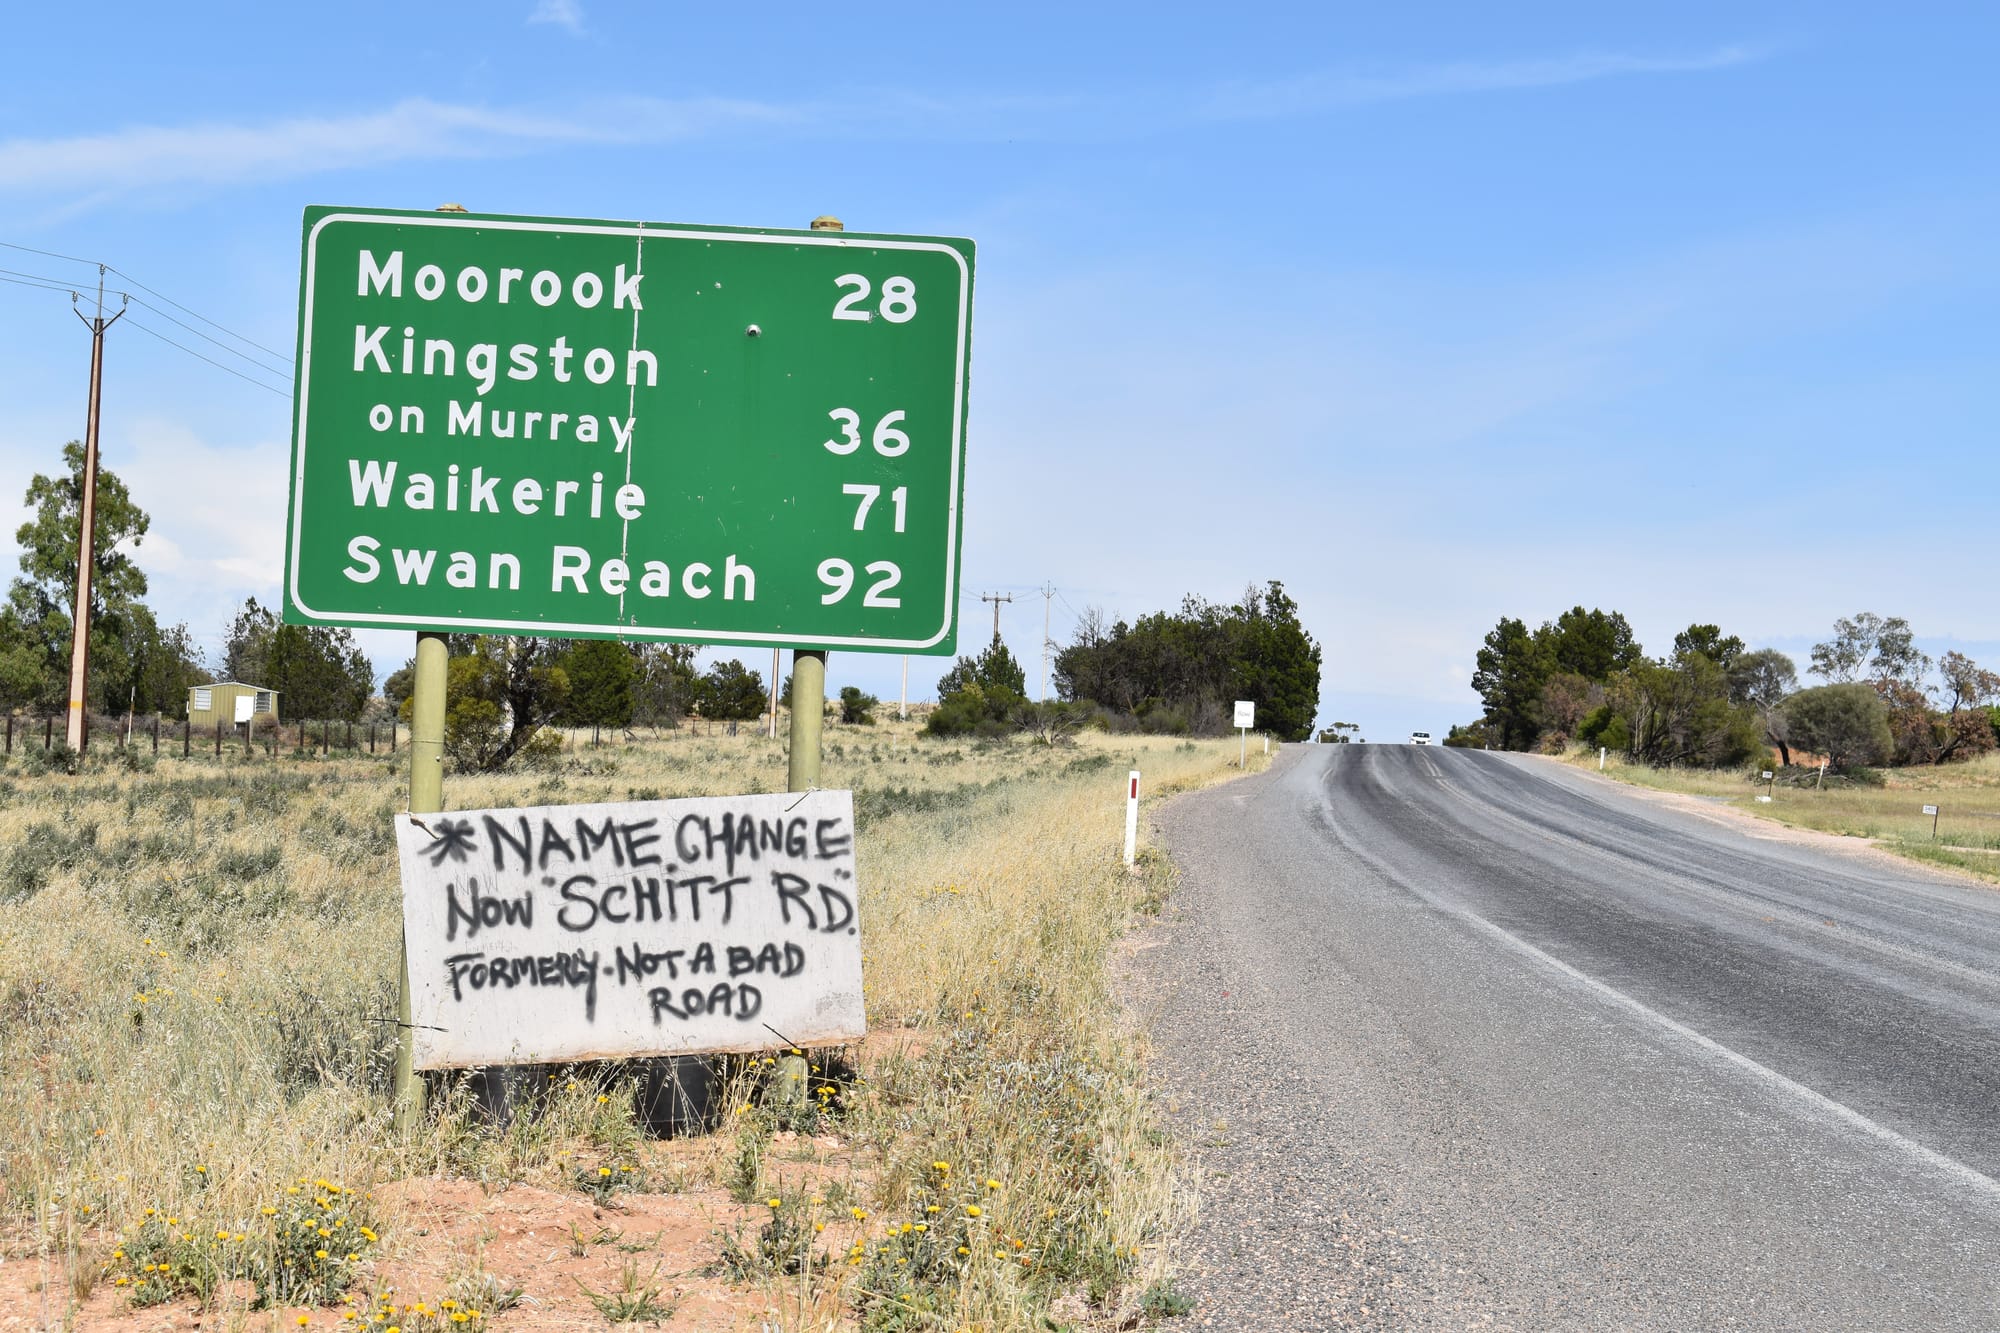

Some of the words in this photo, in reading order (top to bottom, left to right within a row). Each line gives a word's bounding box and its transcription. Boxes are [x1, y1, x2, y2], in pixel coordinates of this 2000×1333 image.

[358, 249, 644, 311] Moorook
[833, 273, 917, 324] 28
[353, 325, 658, 396] Kingston
[369, 404, 425, 434] on
[448, 400, 636, 453] Murray
[824, 408, 911, 457] 36
[349, 460, 646, 521] Waikerie
[842, 484, 908, 533] 71
[343, 535, 521, 590] Swan
[552, 545, 756, 602] Reach
[817, 558, 902, 608] 92
[675, 811, 851, 876] CHANGE
[688, 941, 716, 975] A
[726, 942, 806, 979] BAD
[648, 981, 763, 1025] ROAD
